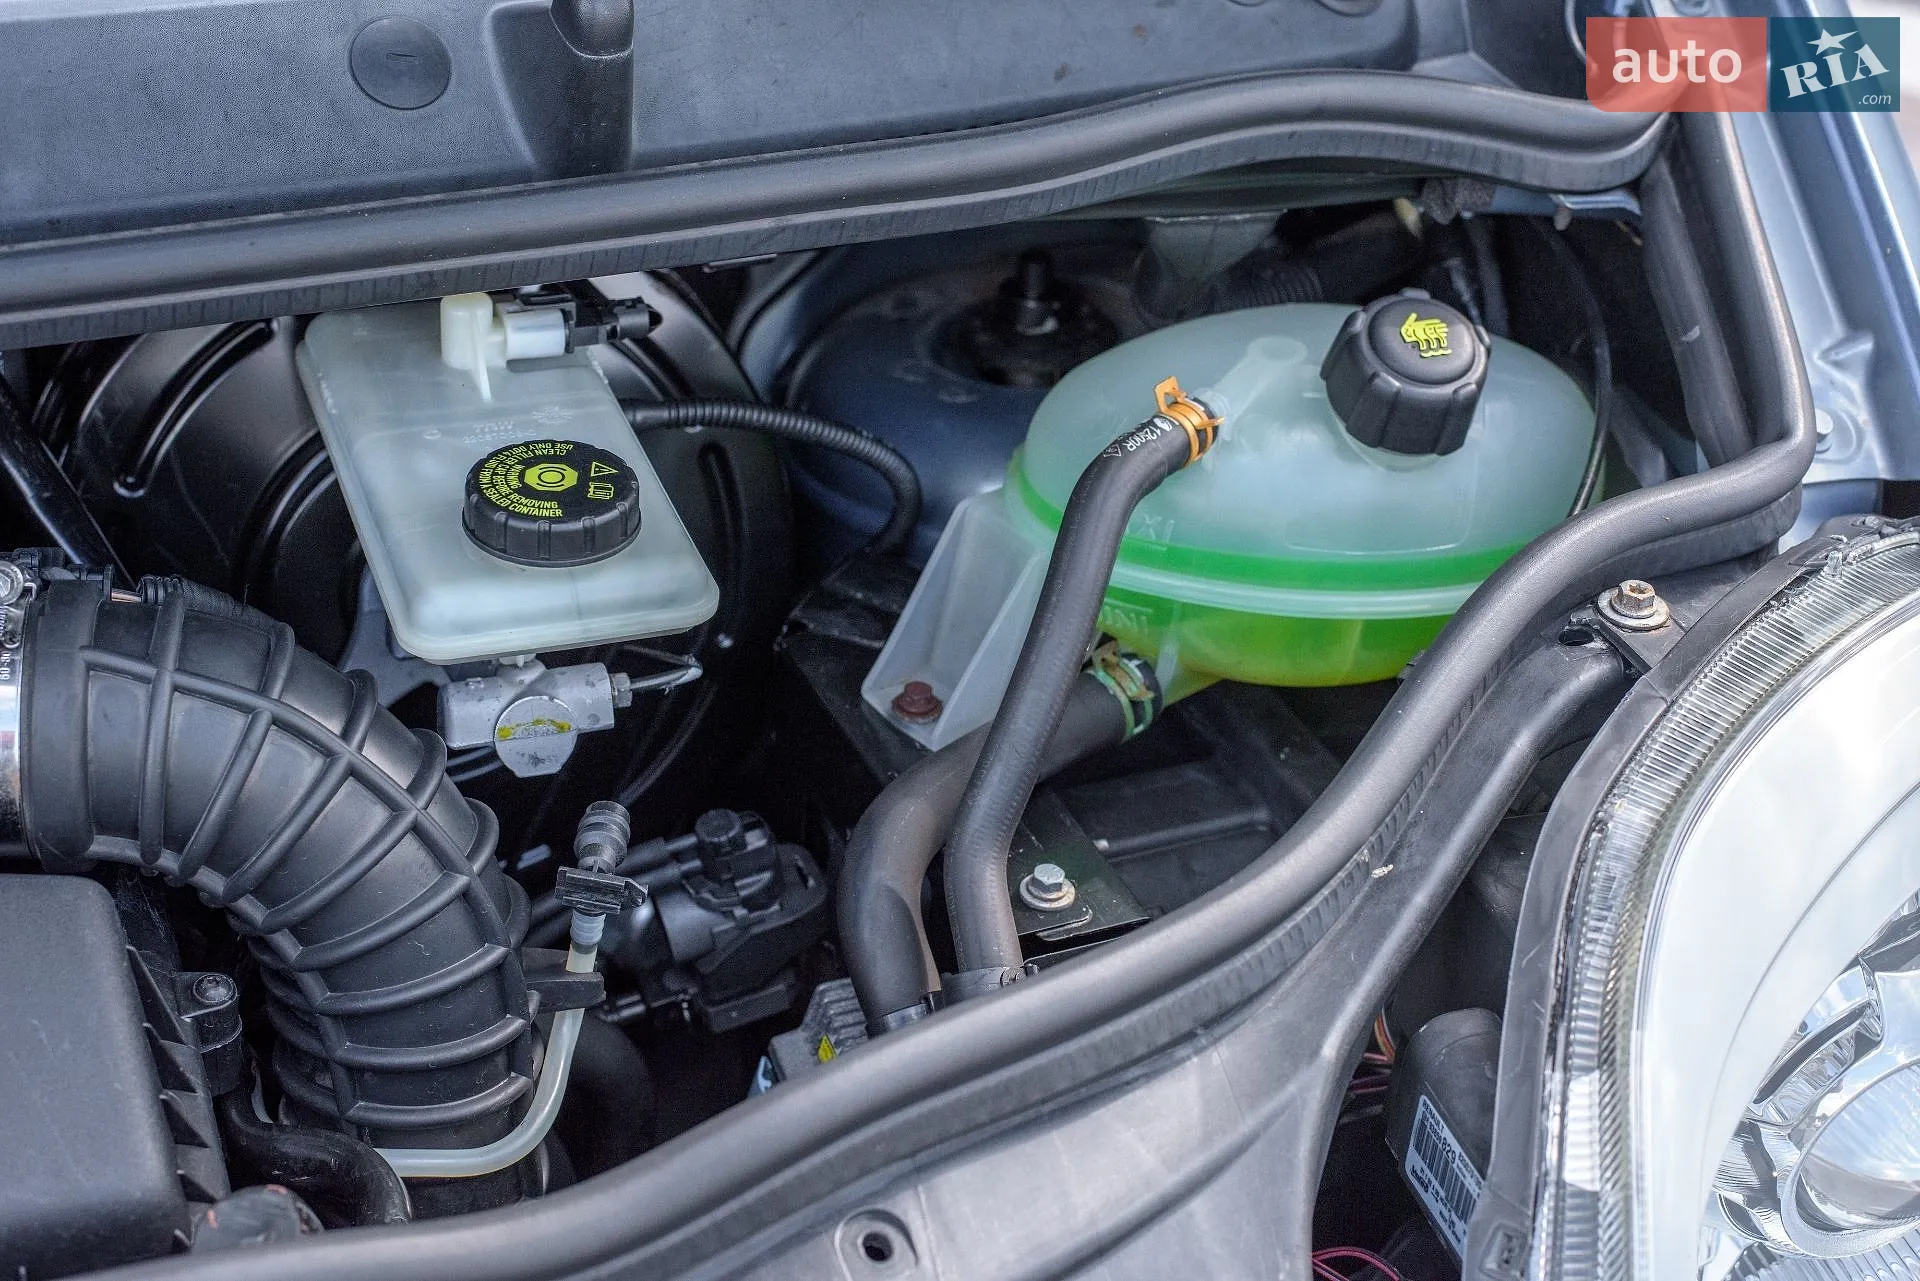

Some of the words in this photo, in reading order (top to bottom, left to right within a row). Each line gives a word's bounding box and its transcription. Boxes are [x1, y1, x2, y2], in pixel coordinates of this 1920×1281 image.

[529, 442, 552, 450] ONLY
[534, 448, 567, 456] CLEAN
[484, 454, 507, 468] FLUID
[502, 450, 534, 465] FILLER
[479, 468, 493, 483] FROM
[494, 463, 510, 475] CAP
[507, 463, 526, 489] WARNING
[493, 475, 515, 496] BEFORE
[483, 488, 511, 507] SEALED
[507, 493, 558, 510] REMOVING
[508, 503, 563, 517] CONTAINER
[1441, 1136, 1457, 1164] 829
